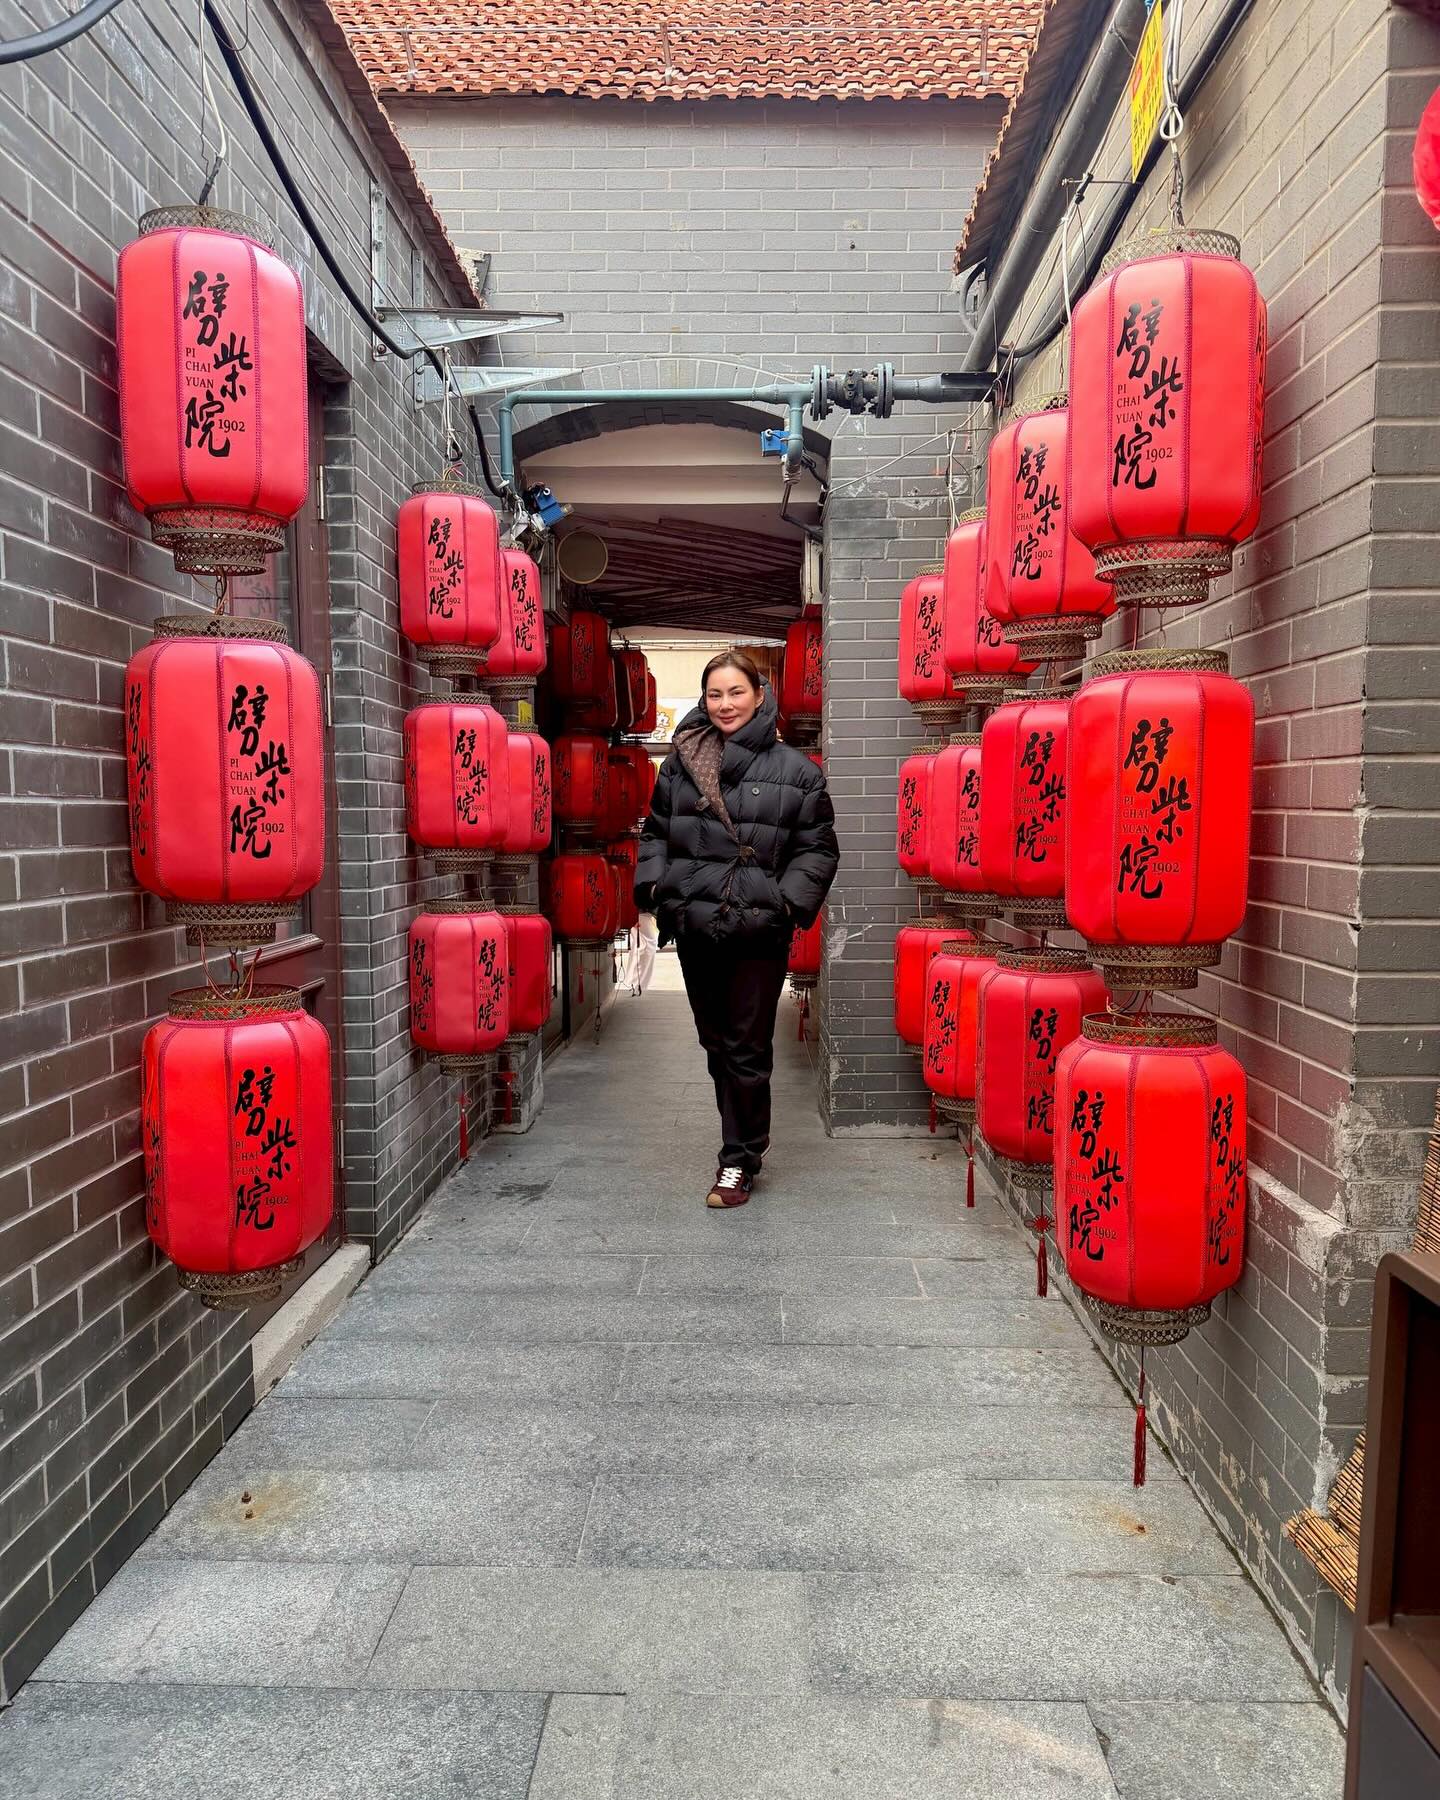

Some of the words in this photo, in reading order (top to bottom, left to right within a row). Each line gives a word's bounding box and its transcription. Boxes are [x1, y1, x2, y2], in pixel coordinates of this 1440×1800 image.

[186, 348, 196, 358] PI
[183, 271, 252, 457] 劈柴院
[185, 360, 211, 373] CHAI
[186, 376, 214, 389] YUAN
[1118, 384, 1126, 394] PI
[1112, 297, 1184, 490] 劈柴院
[1116, 397, 1141, 408] CHAI
[1116, 412, 1143, 424] YUAN
[218, 419, 245, 433] 1902
[1146, 447, 1173, 462] 1902
[1012, 442, 1062, 580] 劈柴院
[1017, 512, 1032, 521] CHAI
[1017, 524, 1033, 532] YUAN
[1034, 550, 1053, 561] 1902
[428, 518, 464, 618] 劈柴院
[915, 595, 942, 678] 劈柴院
[230, 759, 239, 768] PI
[228, 684, 290, 859] 劈柴院
[230, 771, 253, 781] CHAI
[455, 729, 488, 824] 劈柴院
[230, 786, 256, 795] YUAN
[1016, 731, 1066, 862] 劈柴院
[1124, 796, 1134, 806] PI
[1118, 718, 1192, 899] 劈柴院
[1123, 808, 1148, 819] CHAI
[958, 769, 980, 866] 劈院
[261, 822, 284, 835] 1902
[1122, 824, 1150, 834] YUAN
[1152, 862, 1180, 874] 1902
[234, 1066, 297, 1230] 劈柴院
[1070, 1090, 1124, 1262] 劈柴院
[264, 1196, 288, 1206] 1902
[1094, 1227, 1117, 1240] 1902
